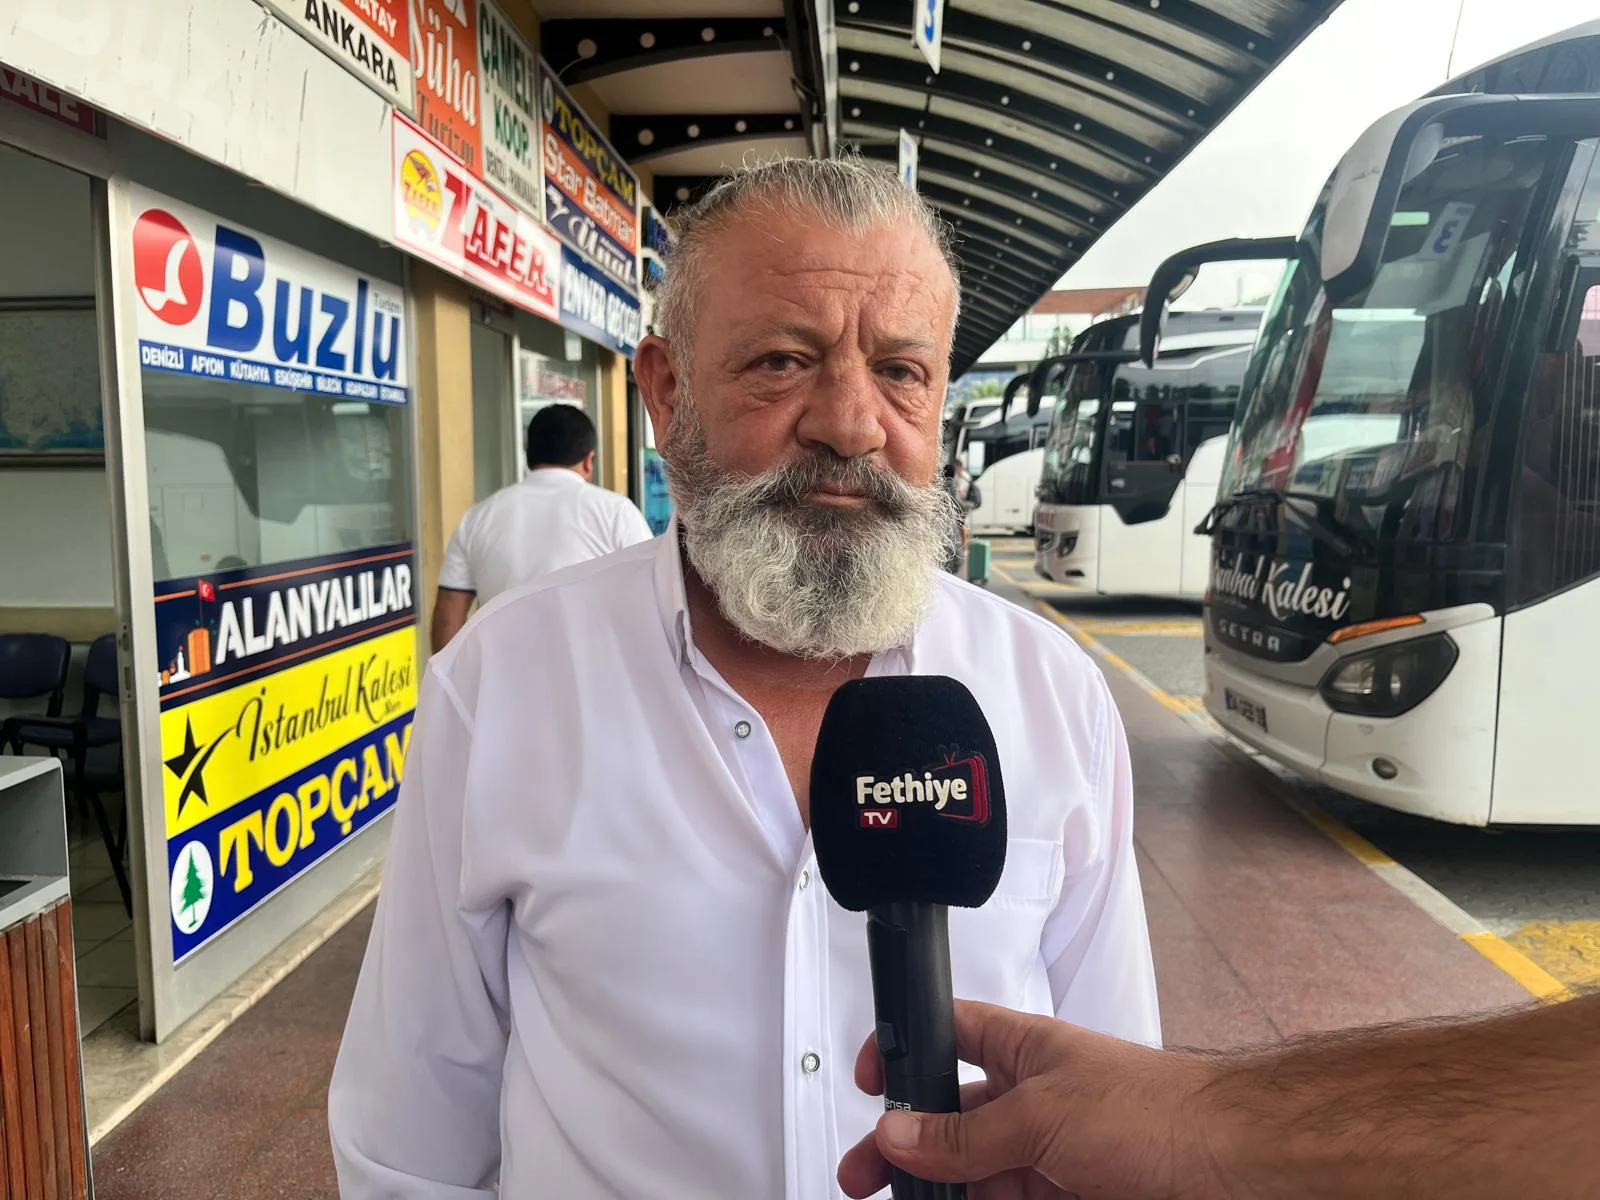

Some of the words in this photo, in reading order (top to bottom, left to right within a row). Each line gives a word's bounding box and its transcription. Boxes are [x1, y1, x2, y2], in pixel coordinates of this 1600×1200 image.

[305, 0, 398, 92] ANKARA
[354, 0, 397, 39] ATAY
[409, 0, 476, 127] Süha
[544, 133, 583, 196] Star
[442, 169, 550, 297] ZAFER
[207, 223, 400, 381] Buzlu
[141, 345, 185, 370] DENİZLİ
[191, 354, 225, 377] AFYON
[229, 360, 271, 384] KÜTAHYA
[214, 563, 412, 665] ALANYALILAR
[1261, 561, 1351, 621] Kalesi
[1219, 619, 1280, 652] SETRA
[235, 664, 352, 762] İstanbul
[354, 653, 411, 724] Kalesi
[219, 723, 413, 893] TOPÇAM
[856, 772, 968, 811] Fethiye
[863, 812, 892, 825] TV
